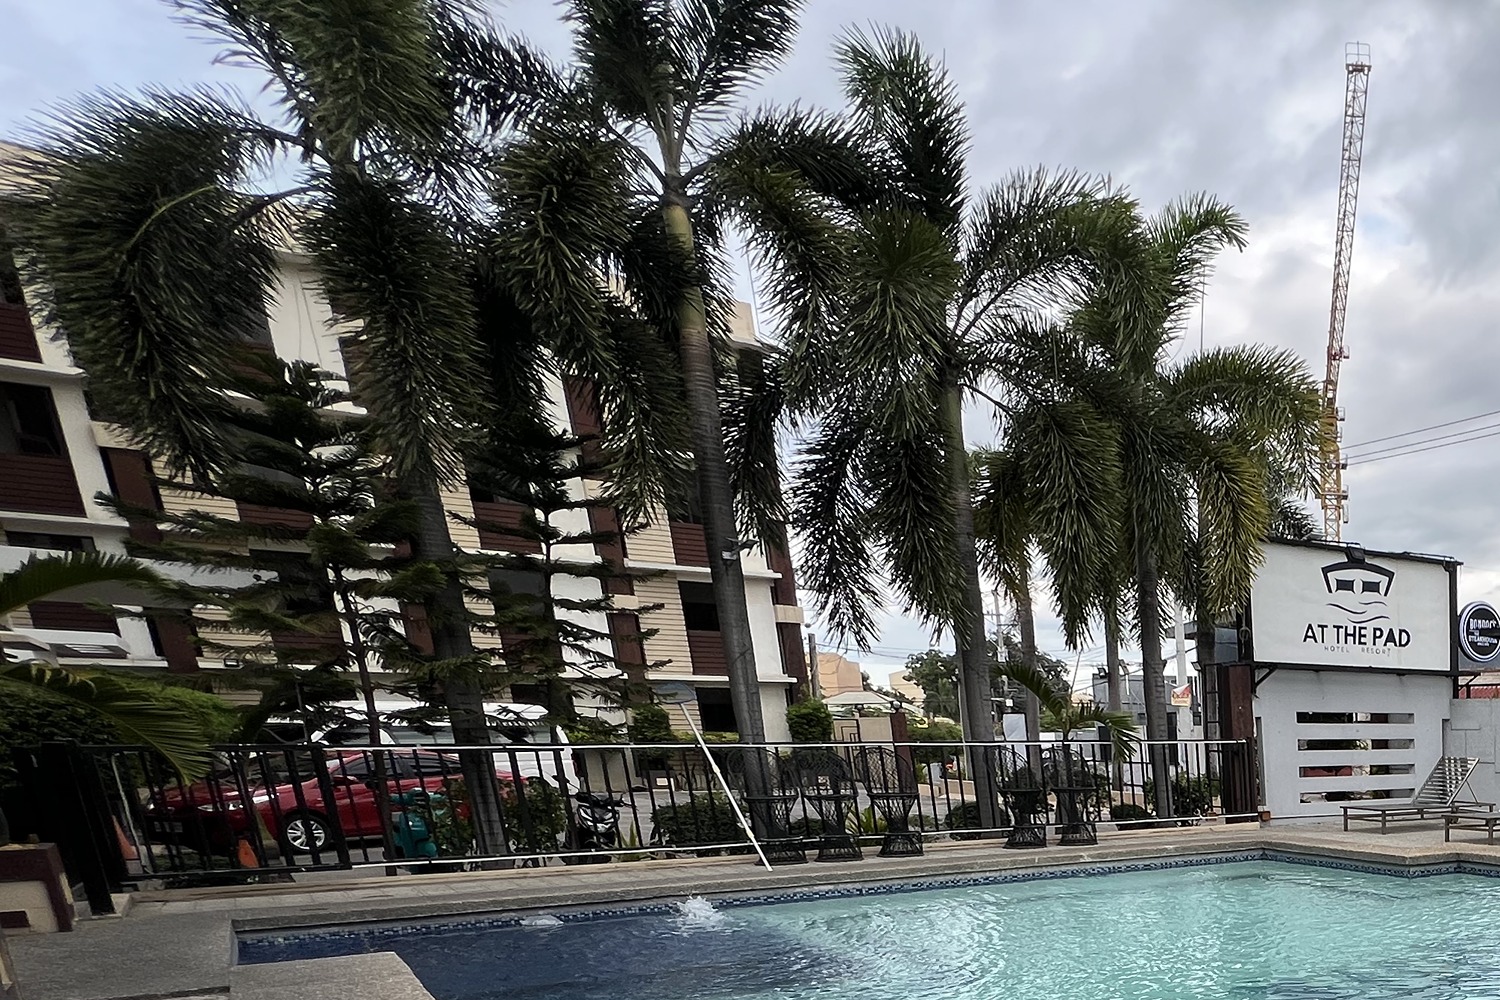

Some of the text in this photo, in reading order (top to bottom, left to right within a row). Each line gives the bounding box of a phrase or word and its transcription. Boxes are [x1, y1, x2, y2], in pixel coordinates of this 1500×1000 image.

[1303, 623, 1410, 647] AT THE PAD
[1324, 645, 1391, 656] HOTEL RESORT
